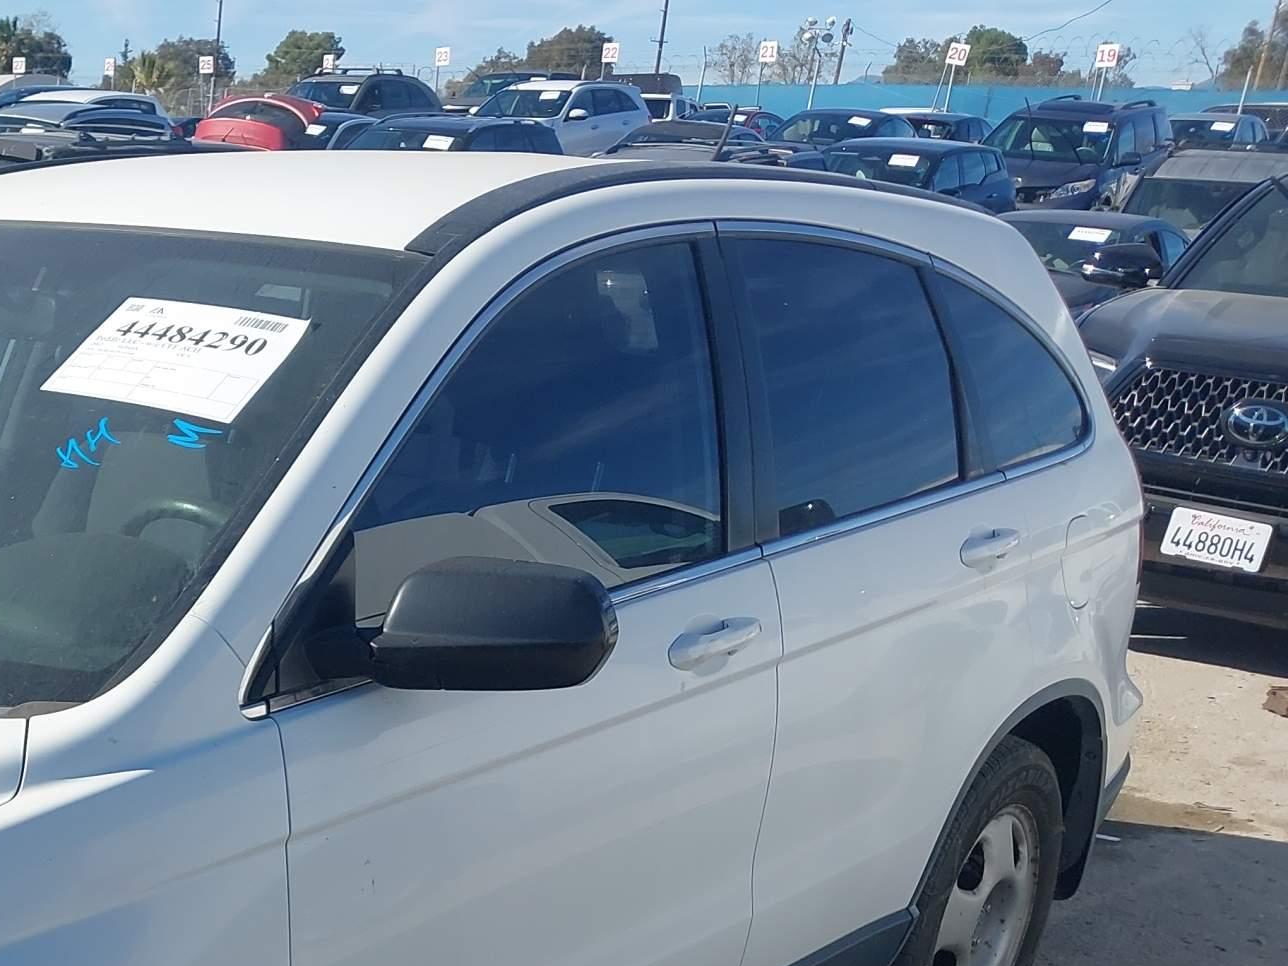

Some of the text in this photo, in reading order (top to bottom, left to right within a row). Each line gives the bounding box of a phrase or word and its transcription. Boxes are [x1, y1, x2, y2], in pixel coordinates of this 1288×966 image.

[437, 50, 449, 63] 23
[603, 47, 618, 59] 22
[761, 47, 775, 58] 21
[948, 47, 967, 61] 20
[1097, 48, 1117, 62] 19
[13, 59, 24, 71] 27
[199, 59, 212, 71] 25
[116, 320, 269, 356] 44484290
[1190, 513, 1251, 536] California
[1170, 526, 1256, 564] 44880H4
